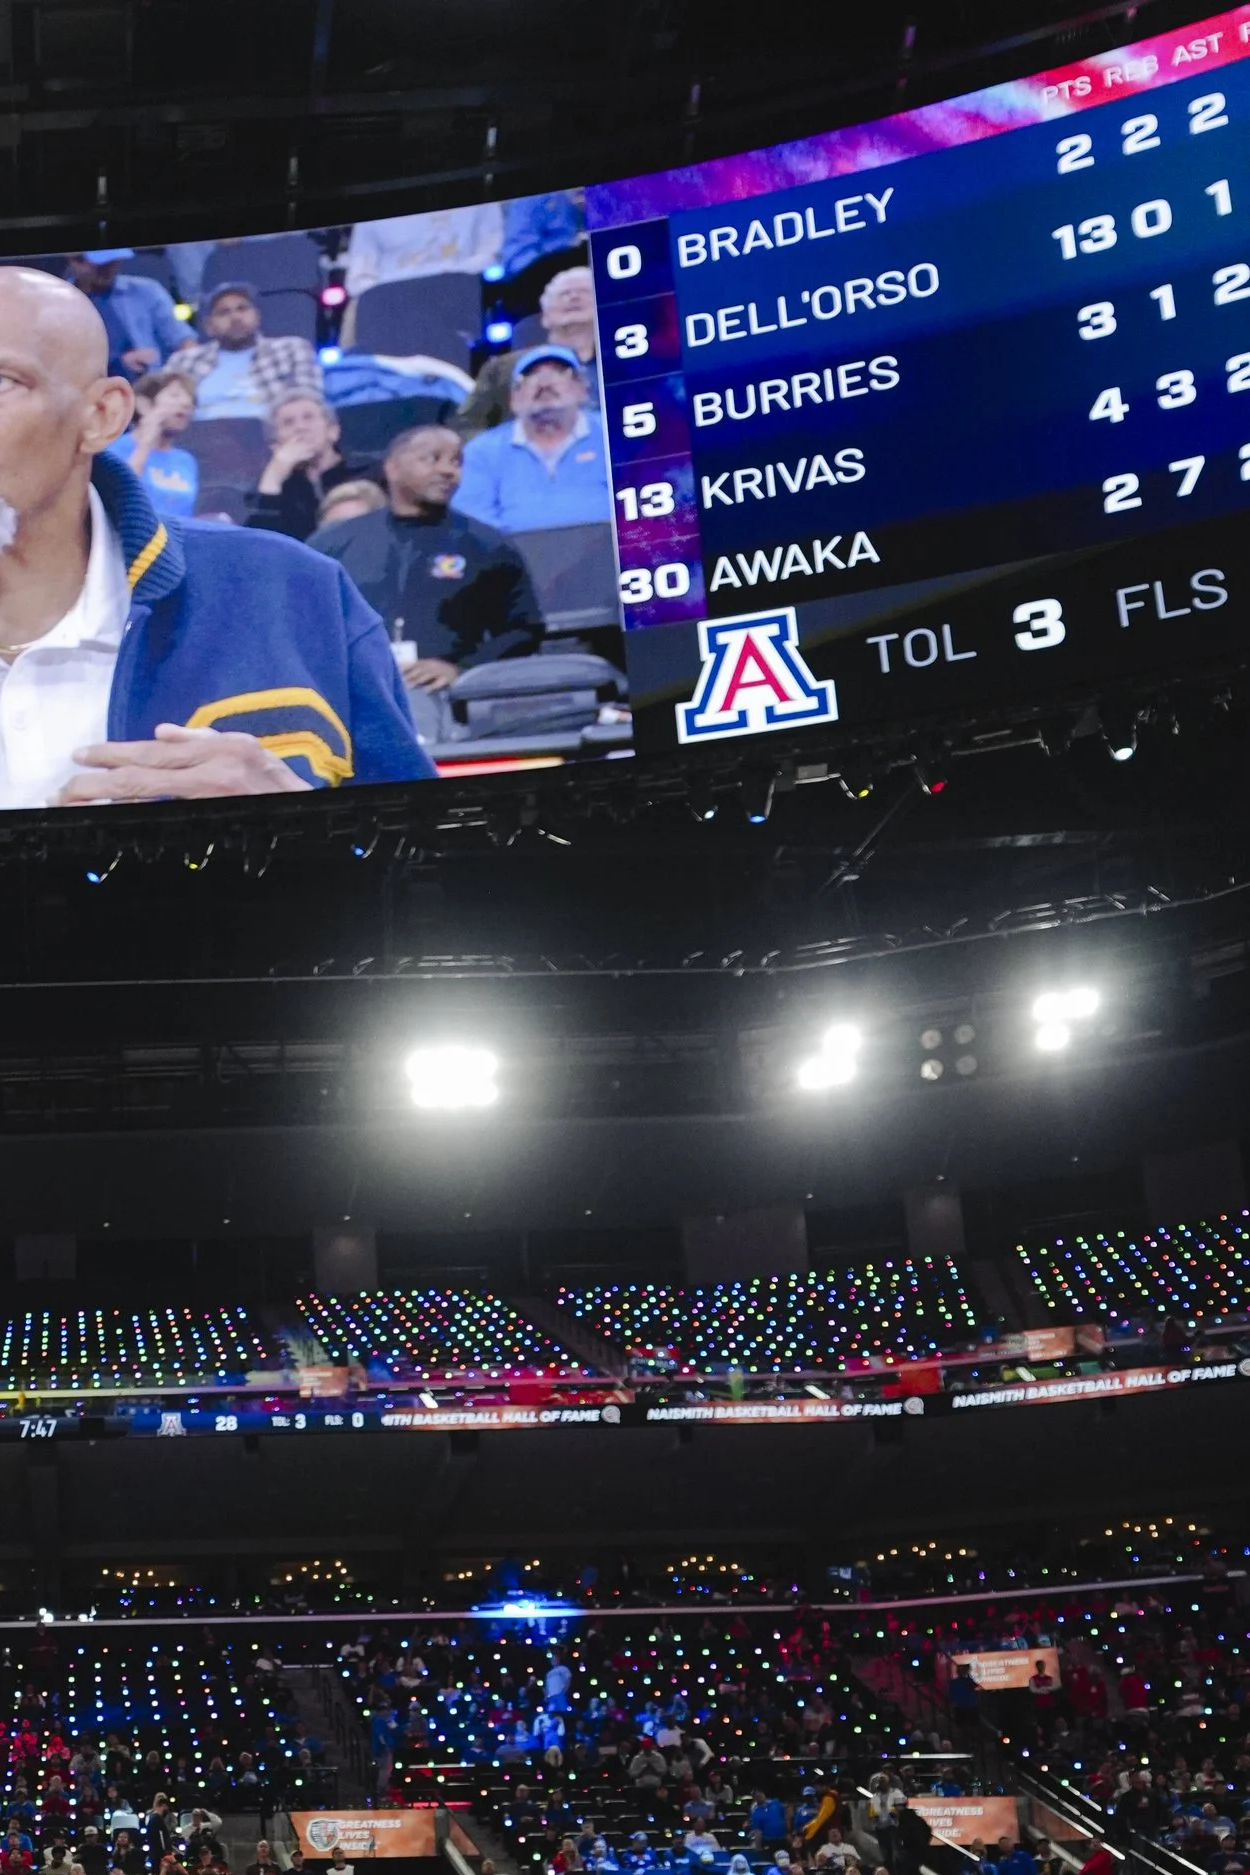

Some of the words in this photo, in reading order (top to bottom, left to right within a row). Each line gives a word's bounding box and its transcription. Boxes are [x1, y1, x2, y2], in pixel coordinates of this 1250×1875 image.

[1040, 75, 1092, 104] PTS
[1103, 55, 1159, 88] REB
[1171, 32, 1224, 67] AST
[608, 246, 641, 278] 0
[679, 188, 893, 266] BRADLEY
[1058, 135, 1094, 173] 2
[1123, 115, 1160, 154] 2
[1190, 93, 1228, 133] 2
[615, 325, 648, 358] 3
[686, 262, 940, 347] DELL'ORSO
[1054, 215, 1117, 258] 13
[1133, 200, 1171, 237] 0
[1207, 180, 1231, 215] 1
[624, 403, 655, 437] 5
[694, 356, 899, 426] BURRIES
[1079, 302, 1116, 339] 3
[1152, 285, 1175, 319] 1
[1214, 264, 1250, 304] 2
[613, 483, 674, 523] 13
[702, 449, 865, 508] KRIVAS
[1090, 388, 1129, 422] 4
[1157, 370, 1196, 408] 3
[619, 563, 689, 603] 30
[711, 532, 880, 591] AWAKA
[1103, 474, 1142, 513] 2
[1169, 456, 1204, 496] 7
[675, 605, 839, 744] A
[867, 624, 976, 672] TOL
[1014, 599, 1065, 650] 3
[1118, 570, 1227, 626] FLS
[952, 1388, 1025, 1408] NAISMITH
[1026, 1378, 1123, 1400] BASKETBALL
[1125, 1373, 1166, 1388] HALL
[1167, 1368, 1191, 1383] OF
[1191, 1364, 1237, 1381] FAME
[19, 1419, 57, 1439] 7:47
[215, 1415, 238, 1431] 28
[295, 1413, 306, 1429] 3
[352, 1412, 364, 1428] 0
[412, 1411, 500, 1426] BASKETBALL
[503, 1410, 538, 1423] HALL
[540, 1410, 560, 1422] OF
[561, 1409, 600, 1422] FAME
[647, 1407, 714, 1420] NAISMITH
[714, 1405, 801, 1418] BASKETBALL
[803, 1404, 840, 1417] HALL
[842, 1403, 862, 1416] OF
[862, 1402, 902, 1416] FAME
[338, 1819, 401, 1829] GREATNESS
[922, 1806, 983, 1817] GREATNESS
[929, 1817, 953, 1827] IVES
[338, 1830, 370, 1839] LIVES
